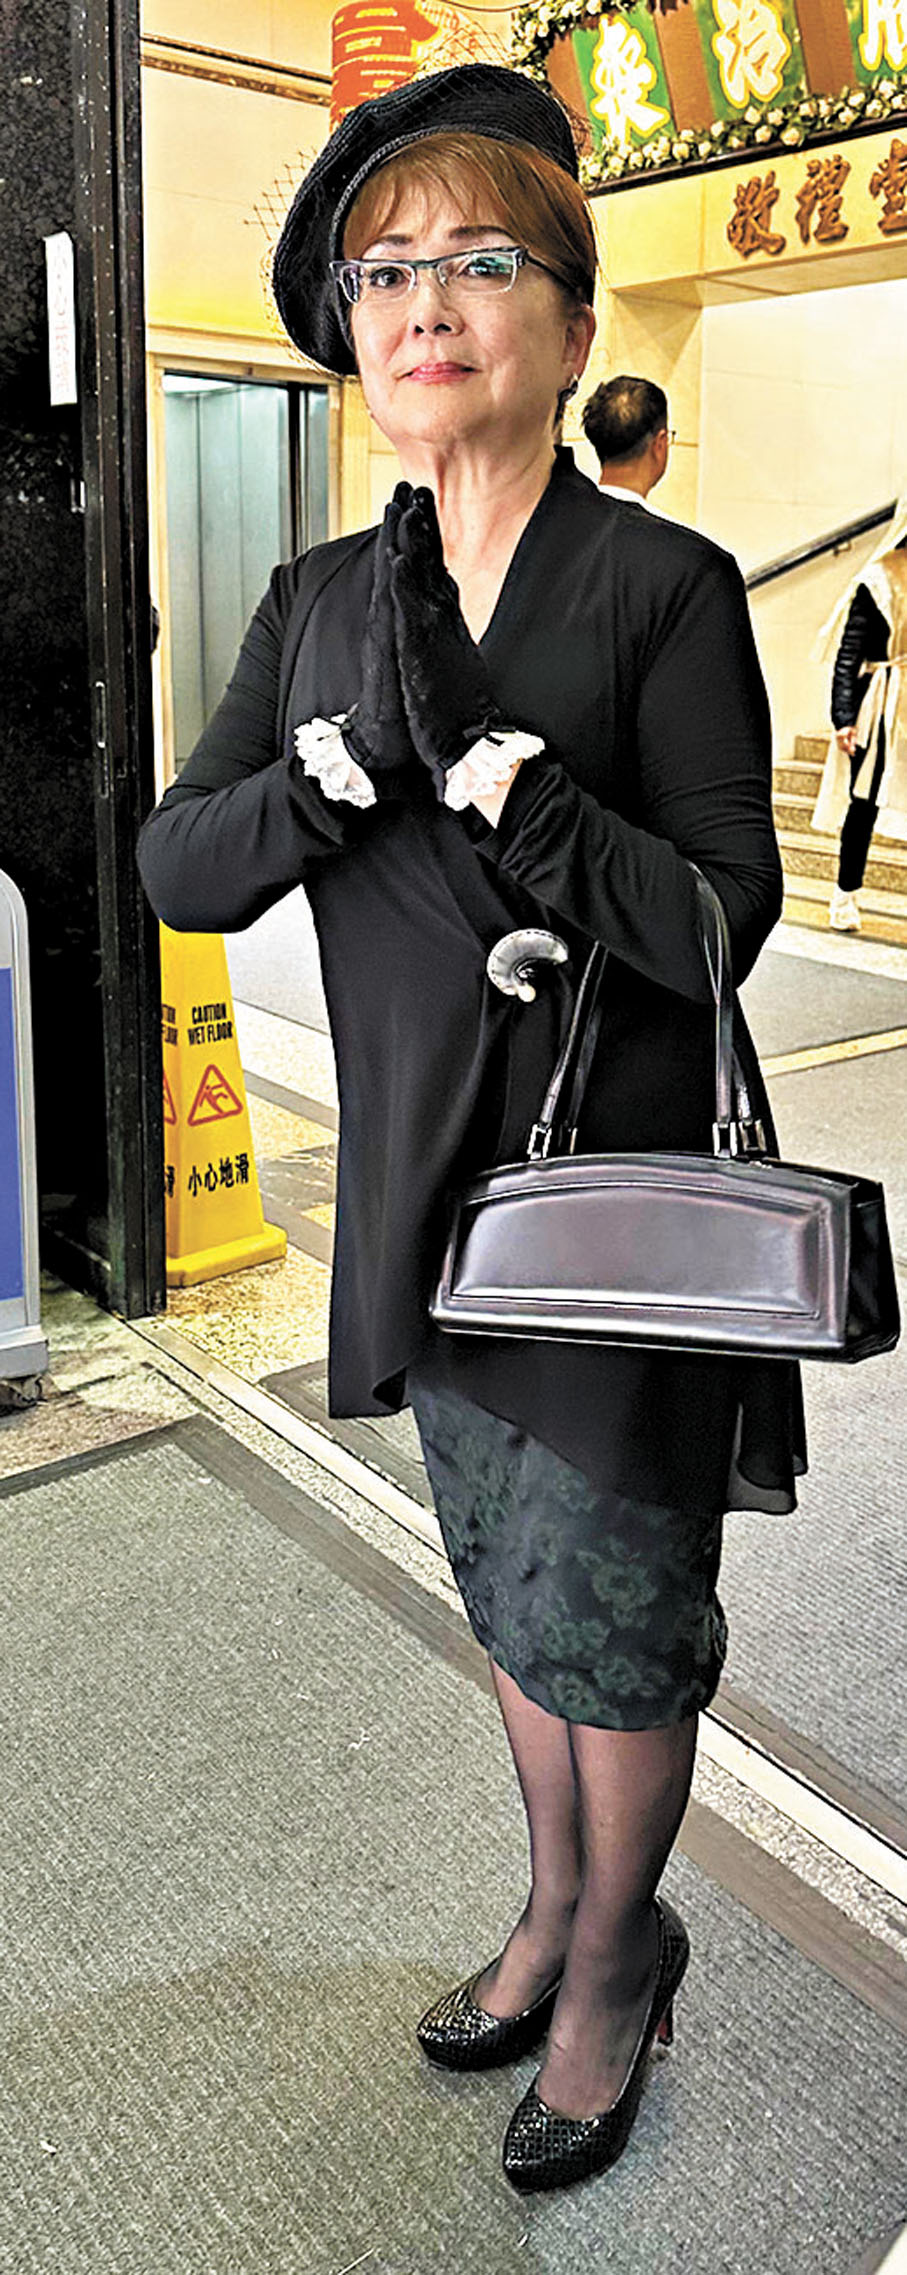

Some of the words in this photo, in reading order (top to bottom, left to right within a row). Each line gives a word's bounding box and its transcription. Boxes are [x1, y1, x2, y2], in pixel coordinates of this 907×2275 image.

[192, 1003, 227, 1025] CAUTION
[187, 1026, 205, 1046] WET
[207, 1021, 233, 1042] FLOOR
[188, 1152, 249, 1197] 小心地滑
